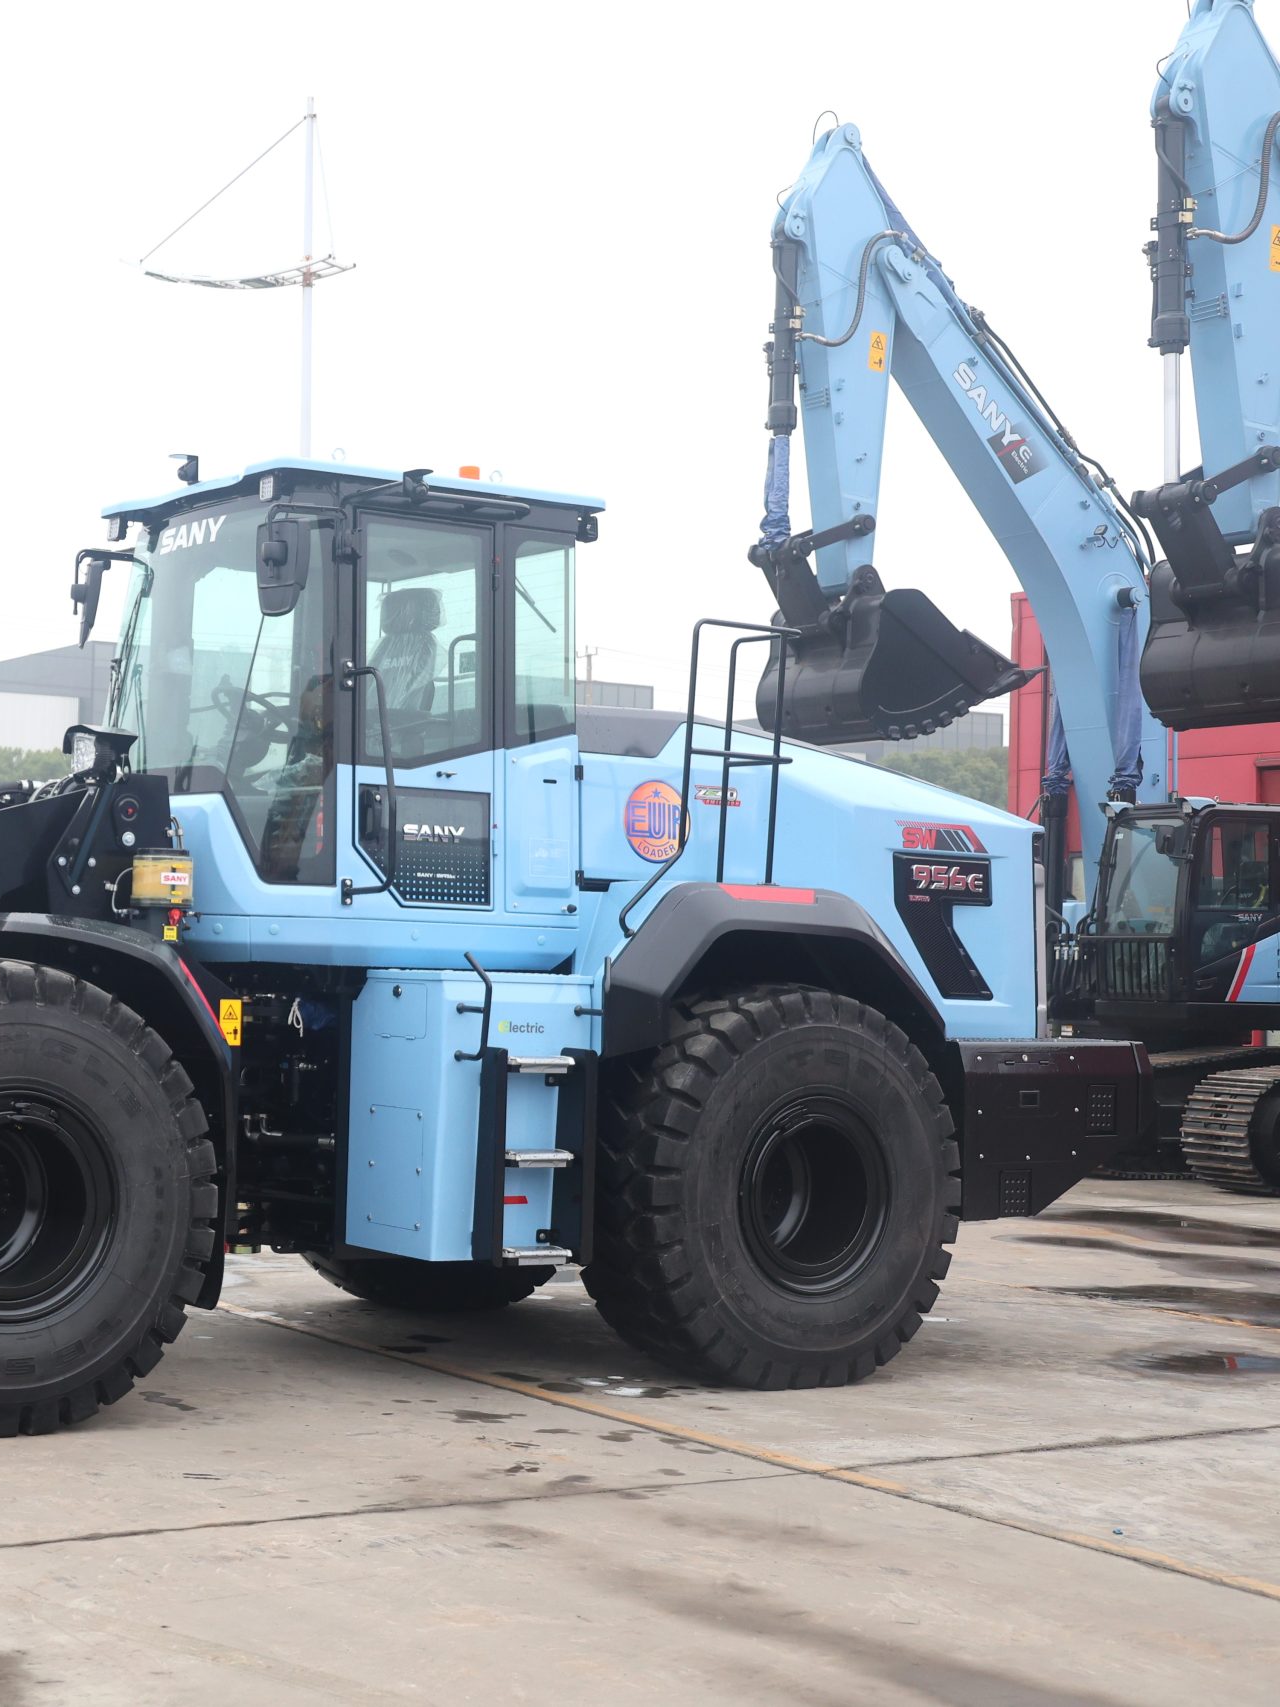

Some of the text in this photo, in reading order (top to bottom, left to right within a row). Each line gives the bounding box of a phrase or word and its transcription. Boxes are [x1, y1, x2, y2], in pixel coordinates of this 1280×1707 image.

[952, 361, 1023, 447] SANY
[1010, 449, 1029, 475] Electric
[160, 514, 227, 556] SANY
[403, 823, 465, 844] SANY
[902, 826, 937, 850] SW
[637, 841, 677, 859] LOADER
[163, 874, 188, 883] SANY
[1238, 912, 1263, 922] SANY
